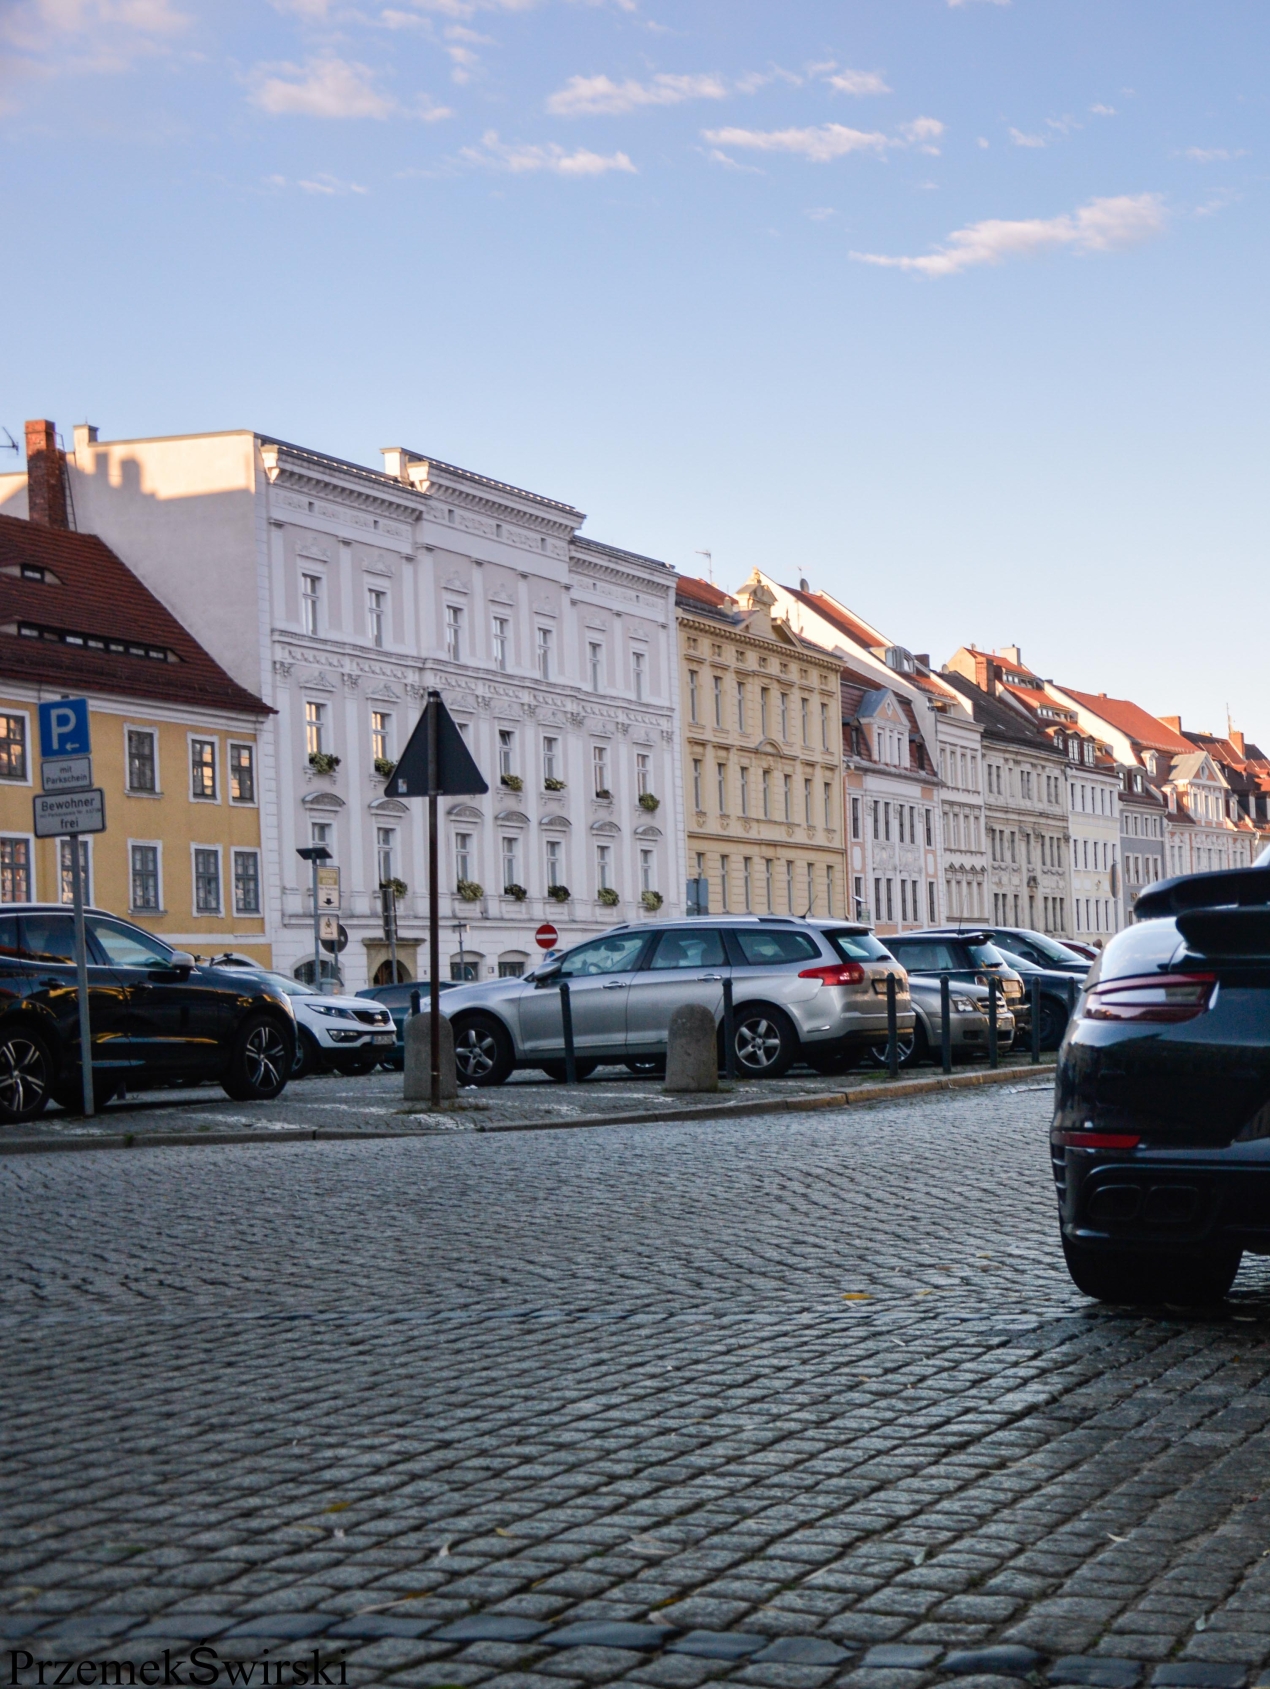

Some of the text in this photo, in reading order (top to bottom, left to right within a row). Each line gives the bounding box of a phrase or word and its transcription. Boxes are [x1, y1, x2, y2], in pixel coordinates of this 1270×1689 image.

[50, 708, 76, 750] P
[60, 766, 72, 774] mit
[46, 774, 87, 786] Parkschein
[41, 797, 95, 812] Bewohner
[60, 817, 79, 829] frei
